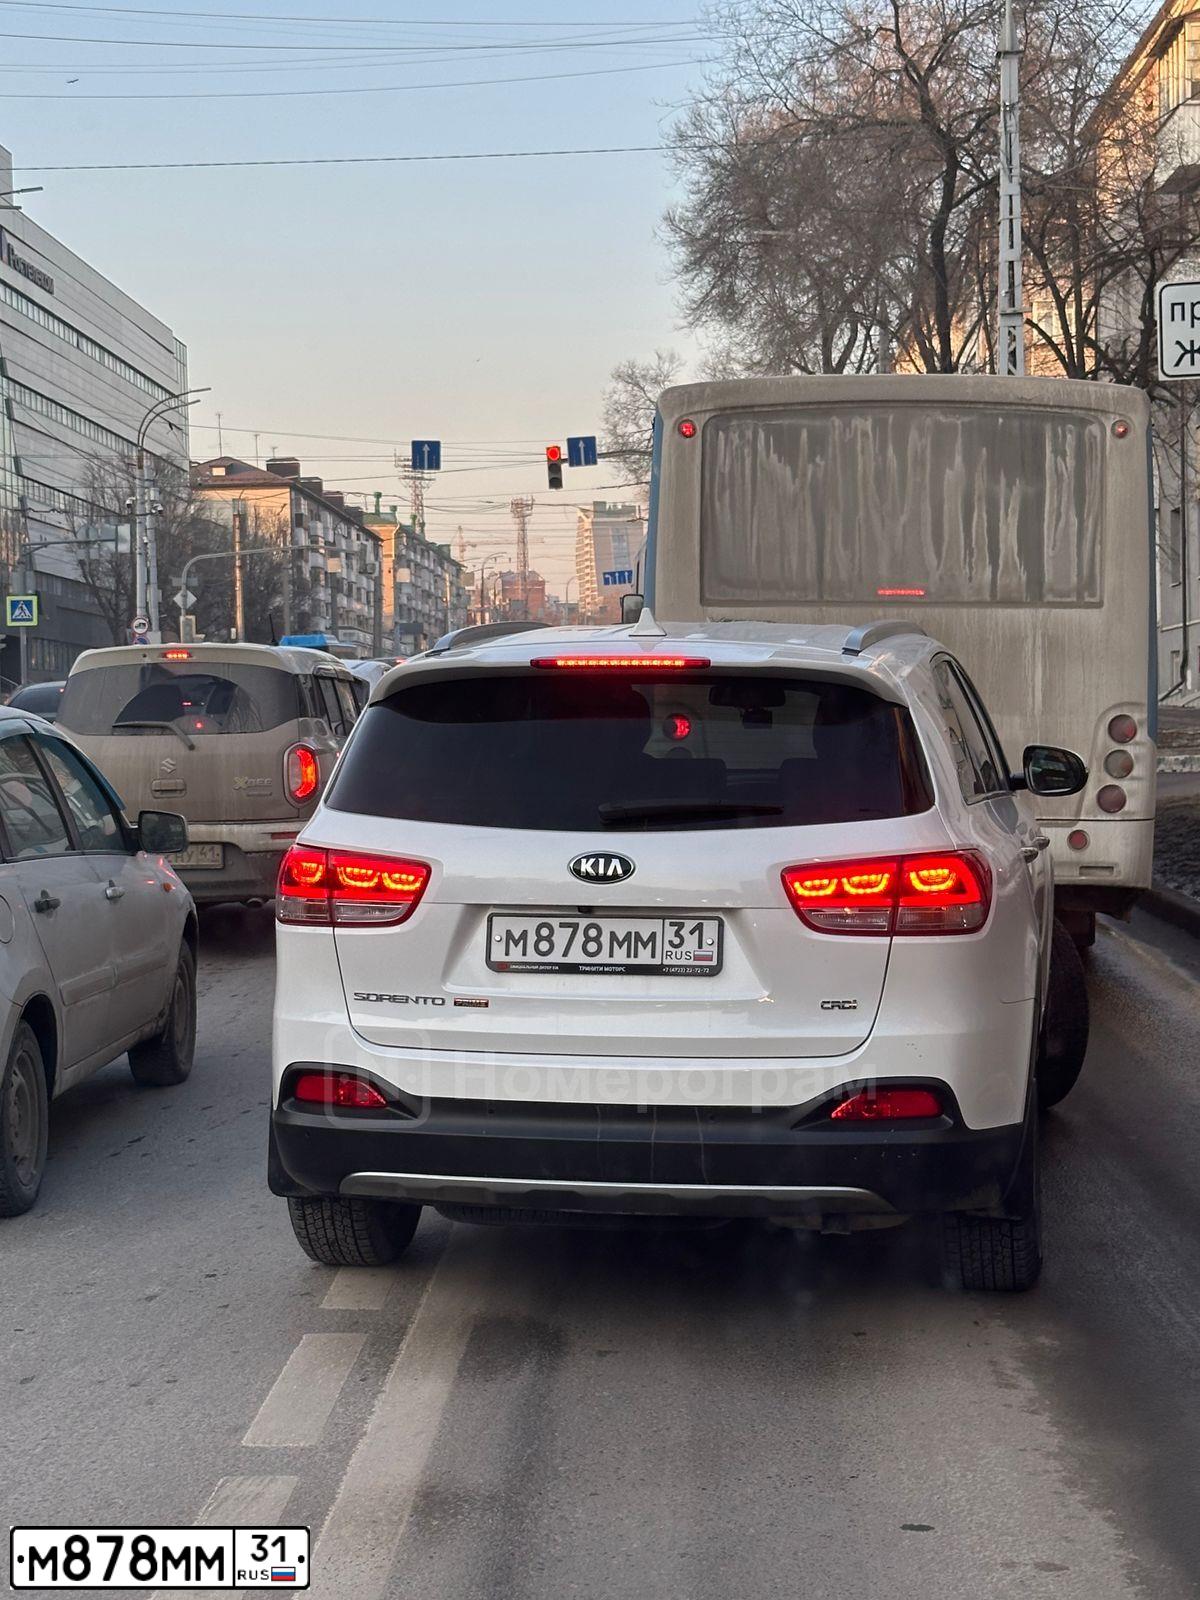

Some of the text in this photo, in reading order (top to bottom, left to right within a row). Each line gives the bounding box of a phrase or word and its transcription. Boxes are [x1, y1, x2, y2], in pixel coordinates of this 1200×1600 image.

[580, 858, 624, 877] KIA
[504, 921, 657, 959] М878ММ
[668, 921, 704, 949] 31
[665, 950, 692, 961] RUS
[353, 992, 446, 1006] SORENTO
